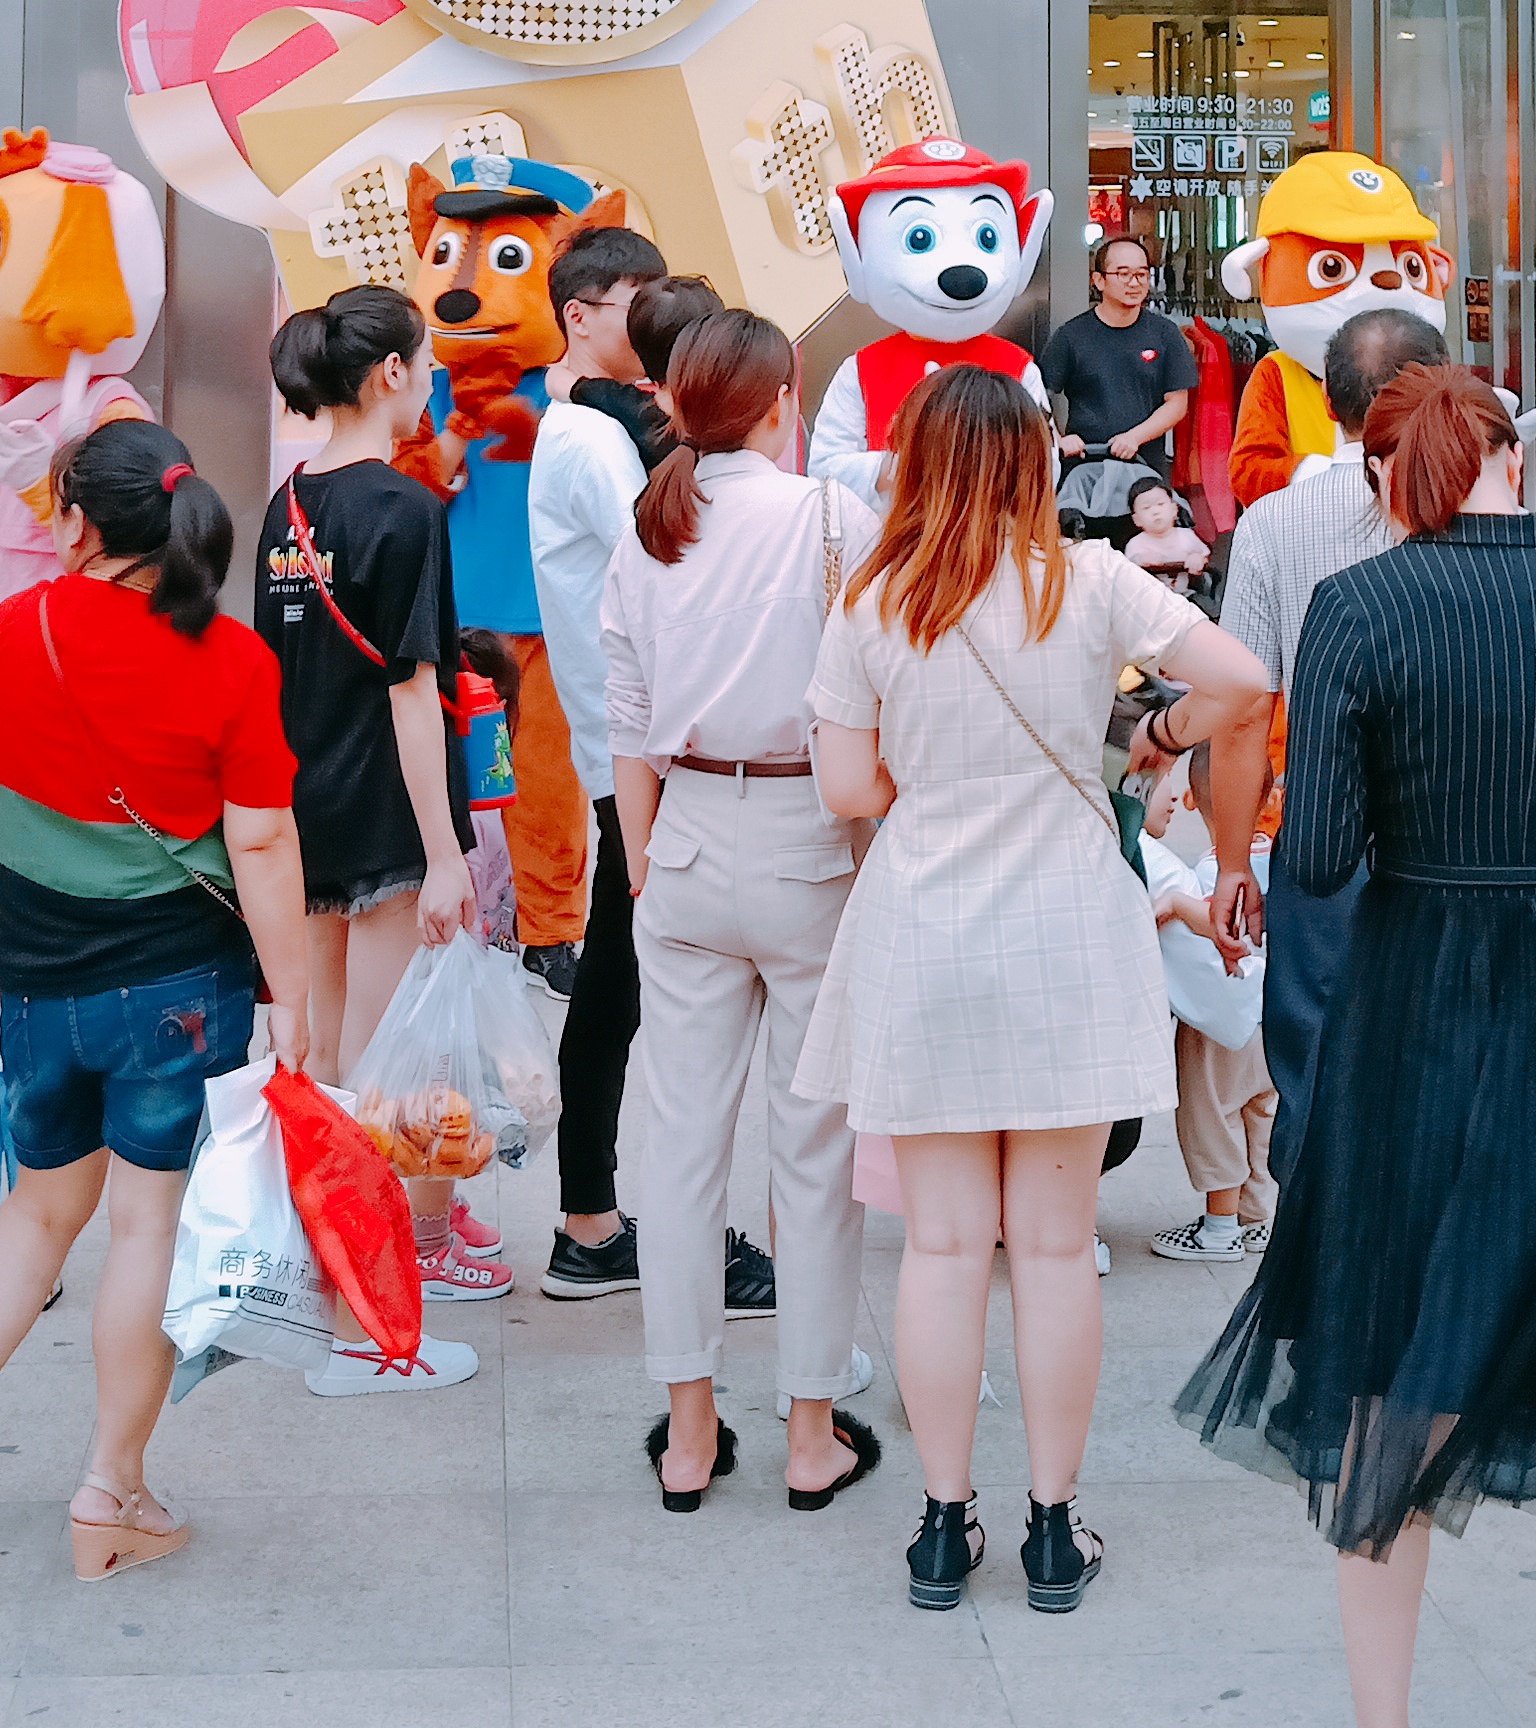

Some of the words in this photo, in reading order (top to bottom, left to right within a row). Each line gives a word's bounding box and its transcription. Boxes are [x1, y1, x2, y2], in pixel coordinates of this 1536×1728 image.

[1126, 96, 1194, 115] 营业时间
[219, 1246, 311, 1290] 商务休闲
